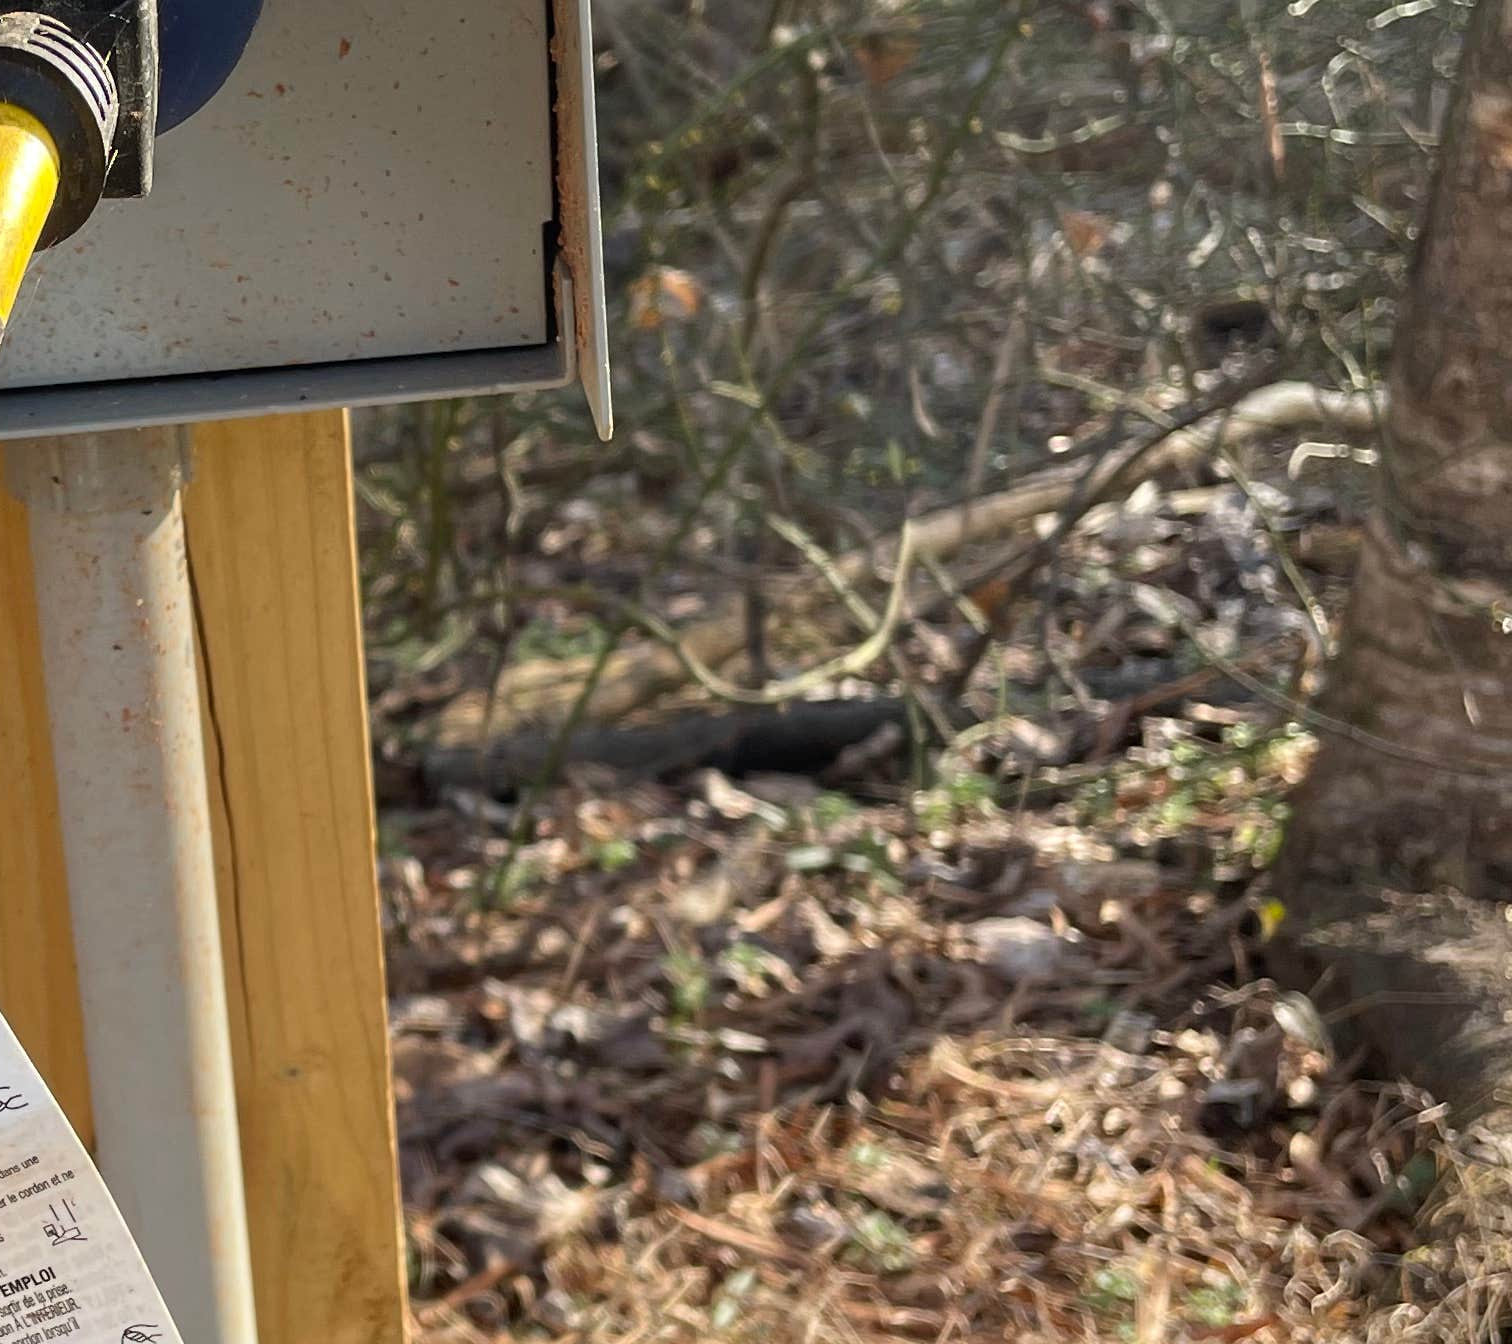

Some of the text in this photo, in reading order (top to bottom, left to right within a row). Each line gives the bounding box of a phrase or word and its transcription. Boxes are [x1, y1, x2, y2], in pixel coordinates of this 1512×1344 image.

[19, 1154, 40, 1169] une
[6, 1191, 18, 1204] le
[17, 1178, 50, 1200] cordon
[49, 1174, 61, 1186] et
[61, 1169, 75, 1182] ne
[20, 1292, 35, 1308] de
[34, 1288, 46, 1304] la
